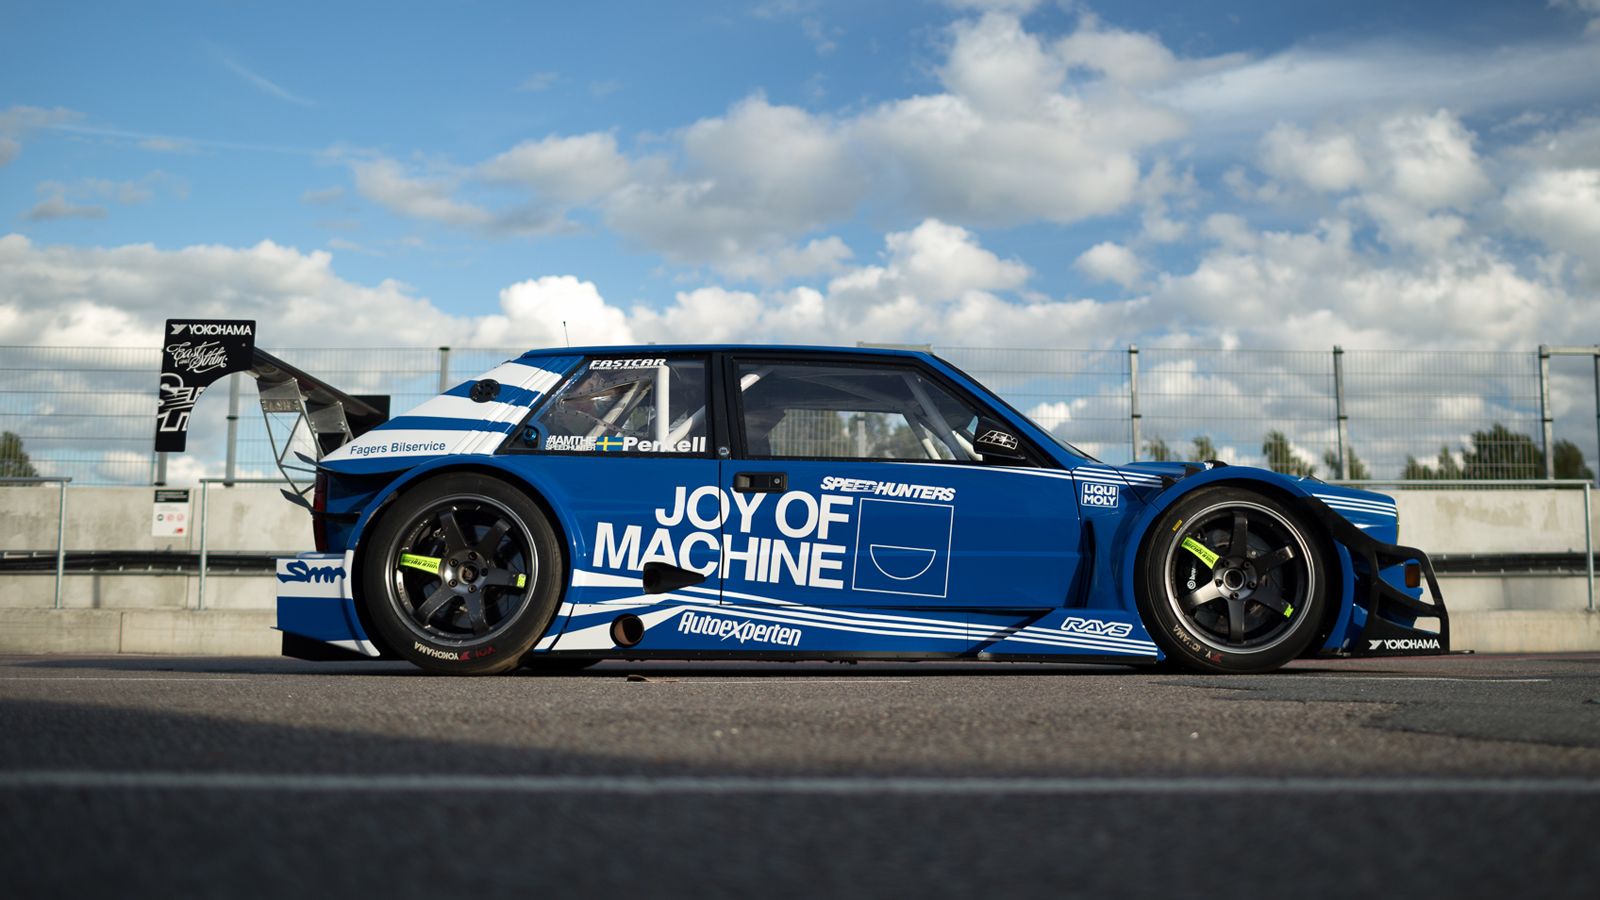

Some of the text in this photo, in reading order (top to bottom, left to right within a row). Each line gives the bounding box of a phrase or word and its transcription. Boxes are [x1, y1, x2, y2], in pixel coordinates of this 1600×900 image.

[188, 324, 252, 335] YOKOHAMA
[590, 358, 667, 367] FASTCAR
[350, 441, 446, 456] Fagers Bilservice
[820, 476, 956, 502] SPEEDHUNTERS
[1084, 484, 1116, 496] LIQUI
[1083, 494, 1117, 506] MOLY
[655, 485, 854, 540] JOY OF
[592, 521, 847, 590] MACHINE
[678, 611, 802, 647] Autoexperten
[1061, 617, 1133, 637] RAYS
[414, 641, 459, 660] YOKOHAMA
[1384, 639, 1440, 649] YOKOHAMA
